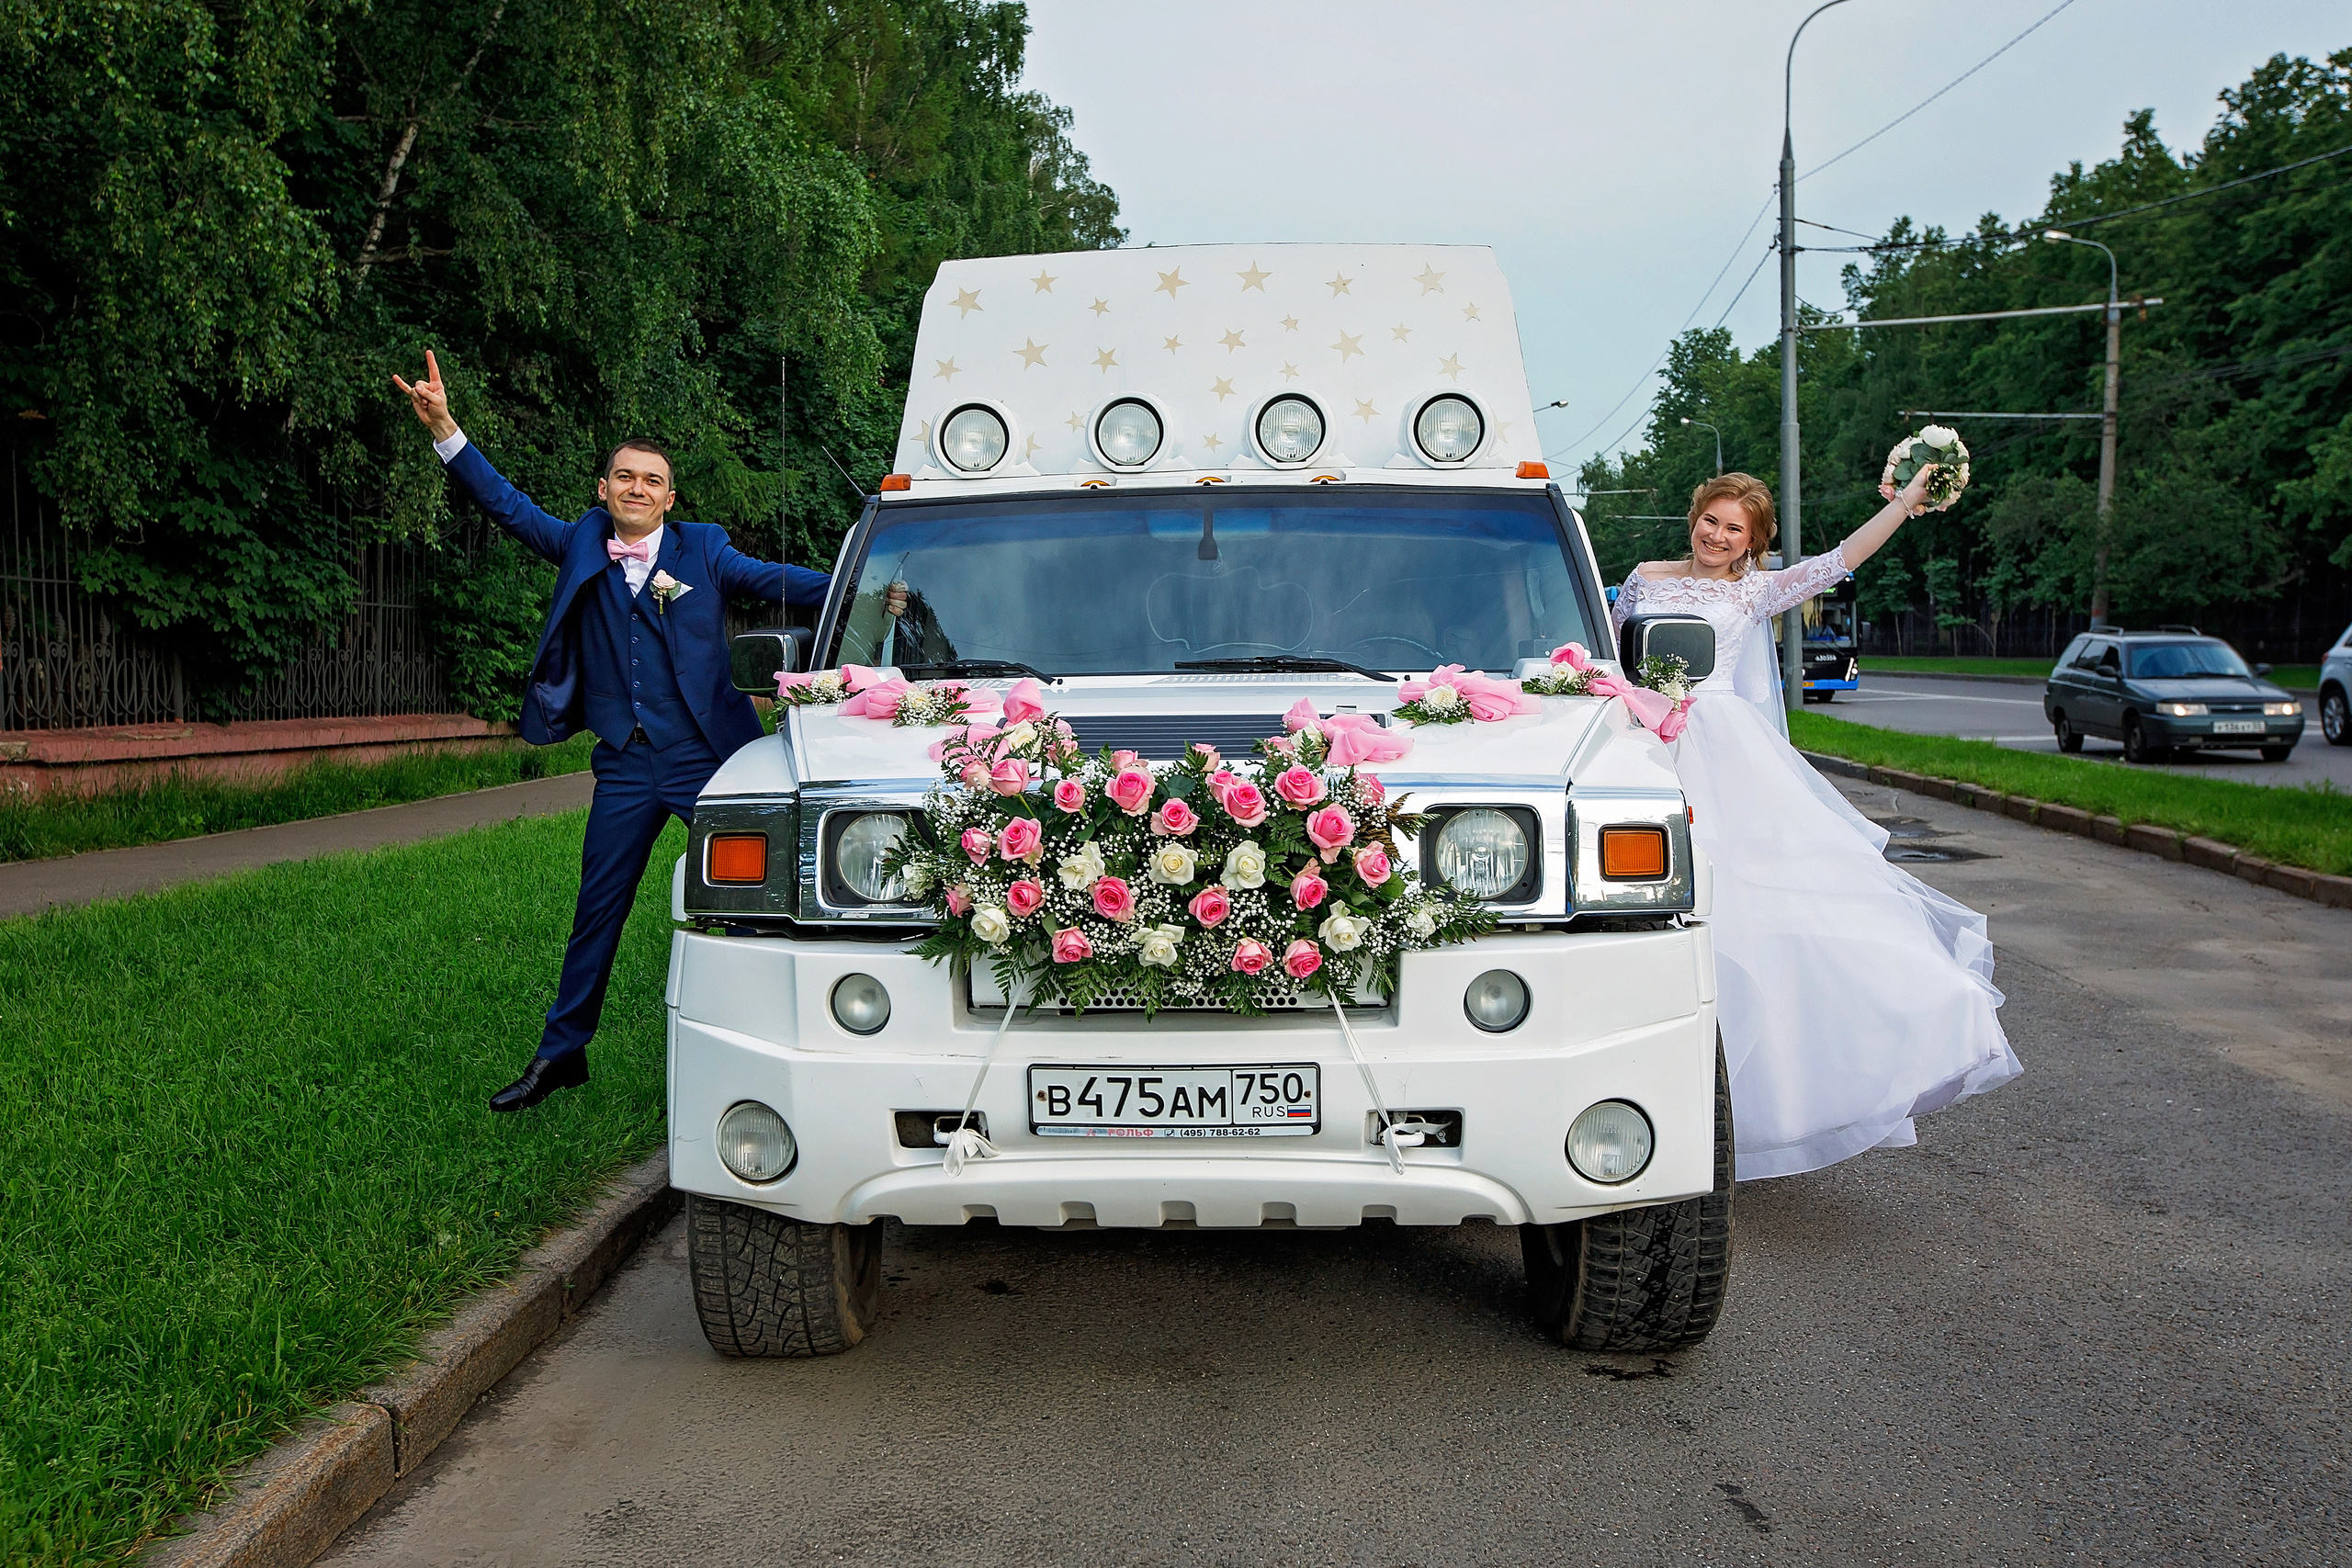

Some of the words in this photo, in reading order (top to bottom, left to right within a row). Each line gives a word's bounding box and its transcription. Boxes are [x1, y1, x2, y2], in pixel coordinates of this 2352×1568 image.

[1047, 1077, 1227, 1118] В475АМ
[1236, 1072, 1304, 1105] 750
[1252, 1105, 1285, 1118] RUS
[1108, 1128, 1154, 1137] РОЛЬФ
[1180, 1128, 1206, 1137] (495)
[1209, 1127, 1261, 1136] 788-62-62
